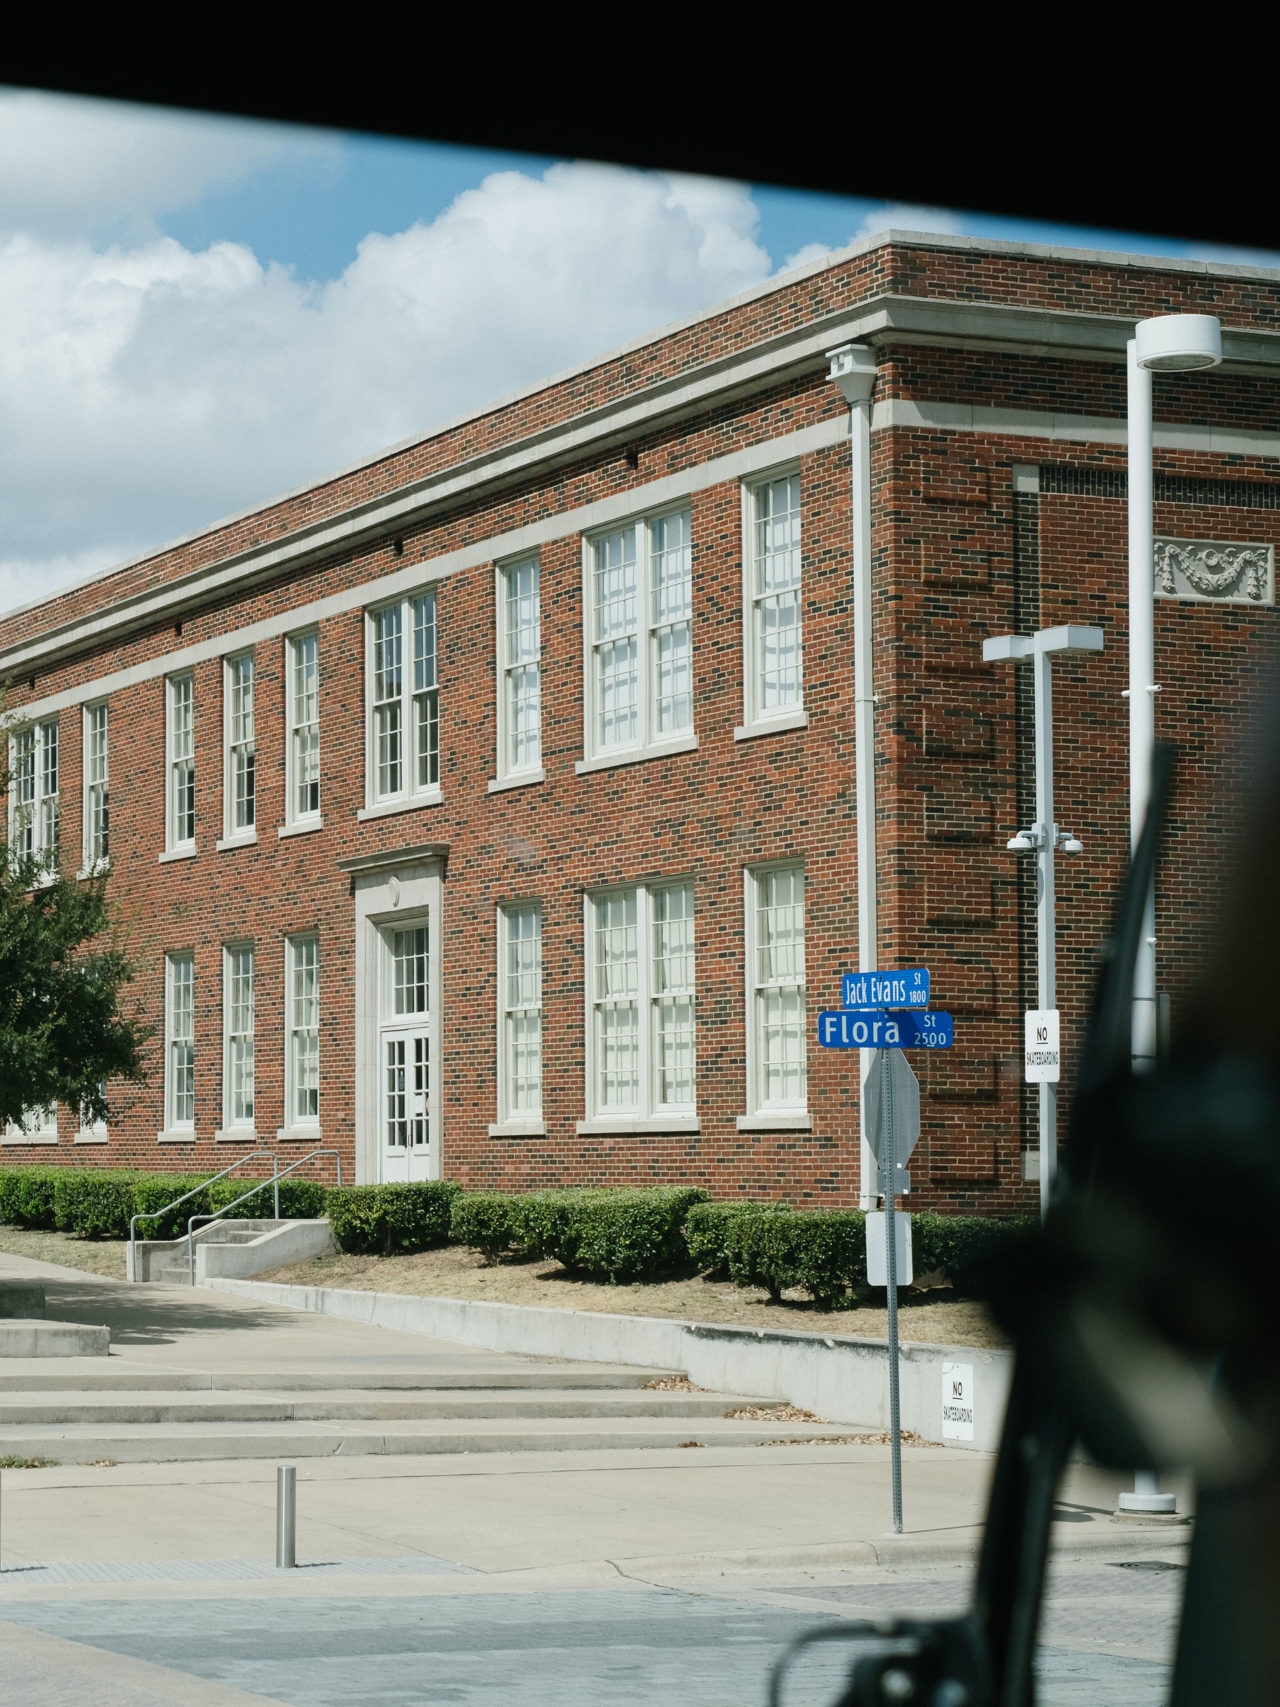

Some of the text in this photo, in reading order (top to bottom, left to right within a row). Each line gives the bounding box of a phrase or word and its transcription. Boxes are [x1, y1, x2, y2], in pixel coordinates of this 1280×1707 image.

[845, 972, 922, 1005] Jack Evans St
[909, 990, 927, 1004] 1800
[825, 1014, 936, 1043] Flora St
[1036, 1026, 1048, 1041] NO
[914, 1032, 947, 1045] 2500
[952, 1381, 963, 1396] NO
